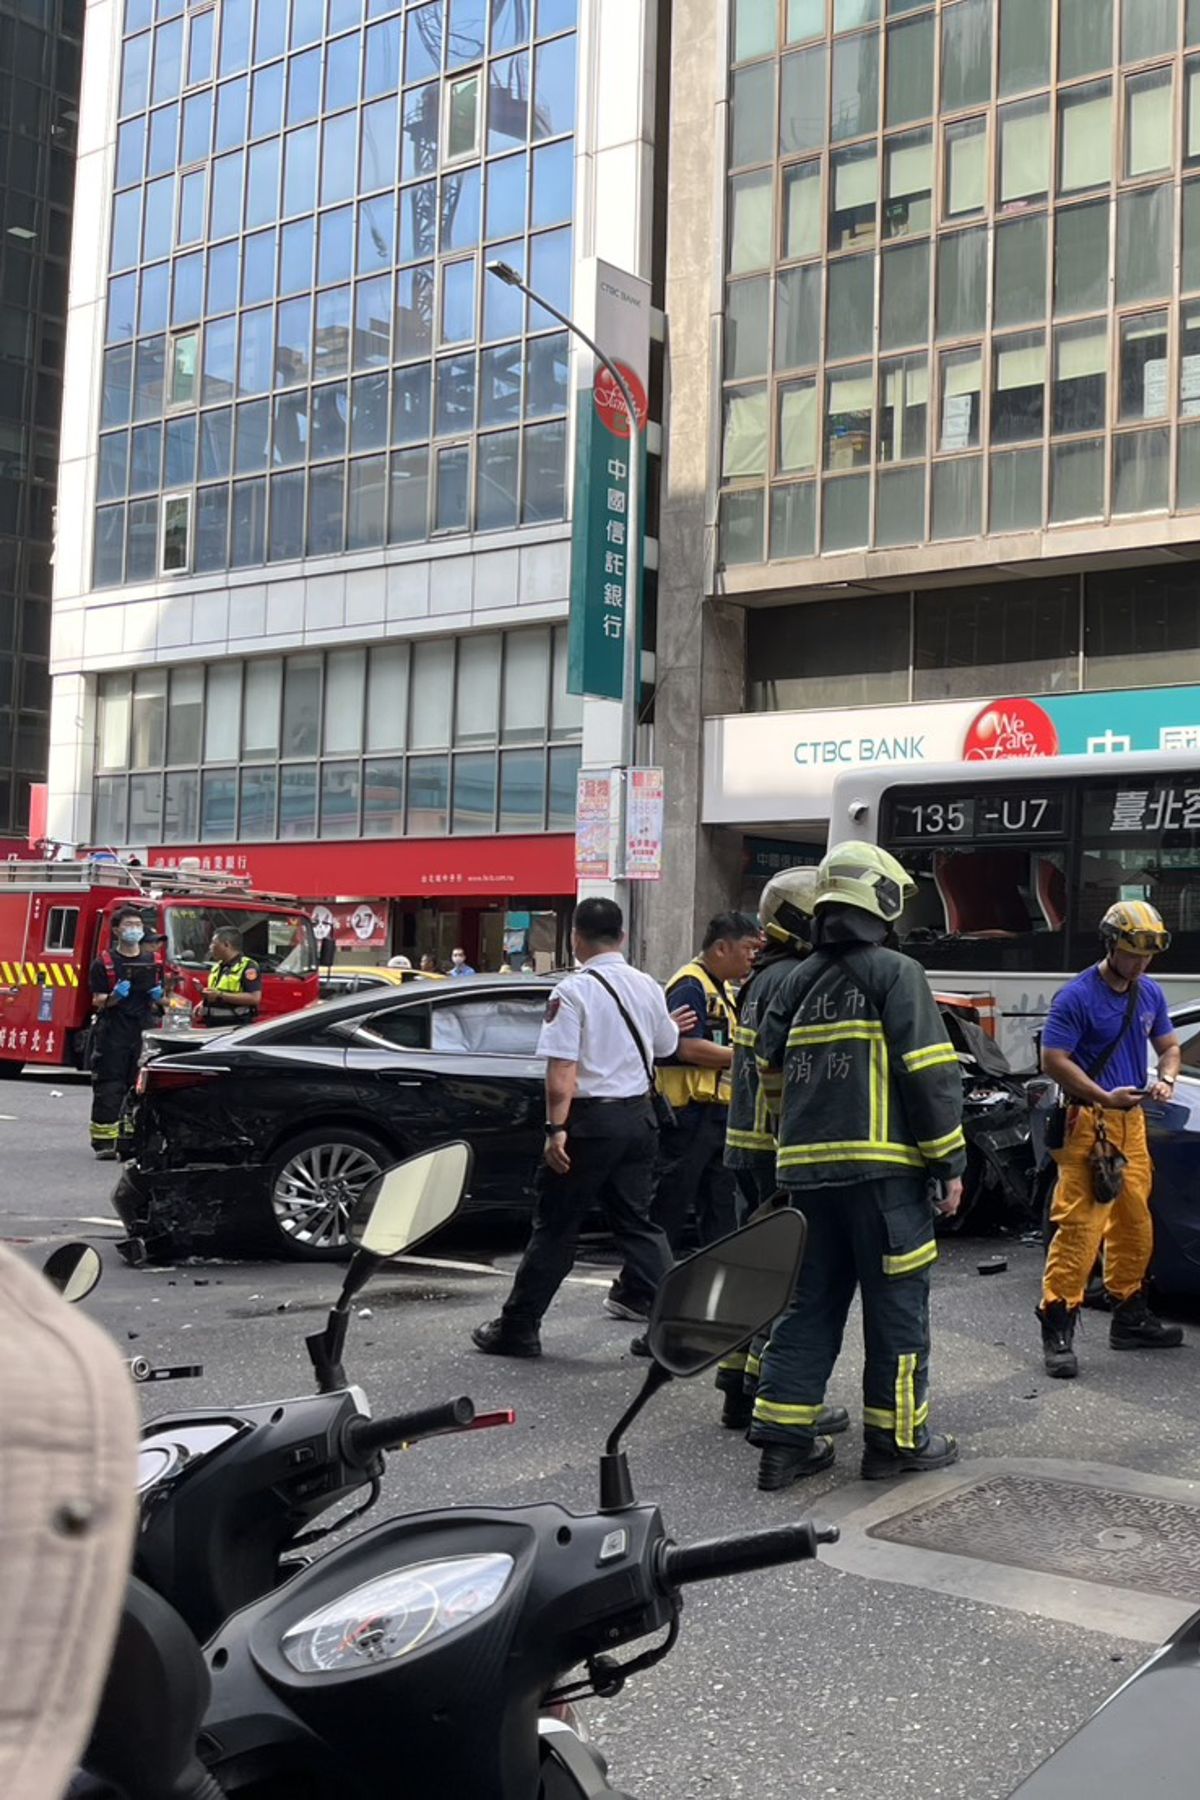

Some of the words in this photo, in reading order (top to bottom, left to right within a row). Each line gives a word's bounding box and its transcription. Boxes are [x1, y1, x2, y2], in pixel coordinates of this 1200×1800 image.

[602, 458, 627, 638] 中國信託銀行
[794, 740, 852, 765] CTBC
[859, 735, 925, 761] BANK
[911, 803, 965, 833] 135
[985, 799, 1050, 830] -U7
[788, 1052, 853, 1084] 消防
